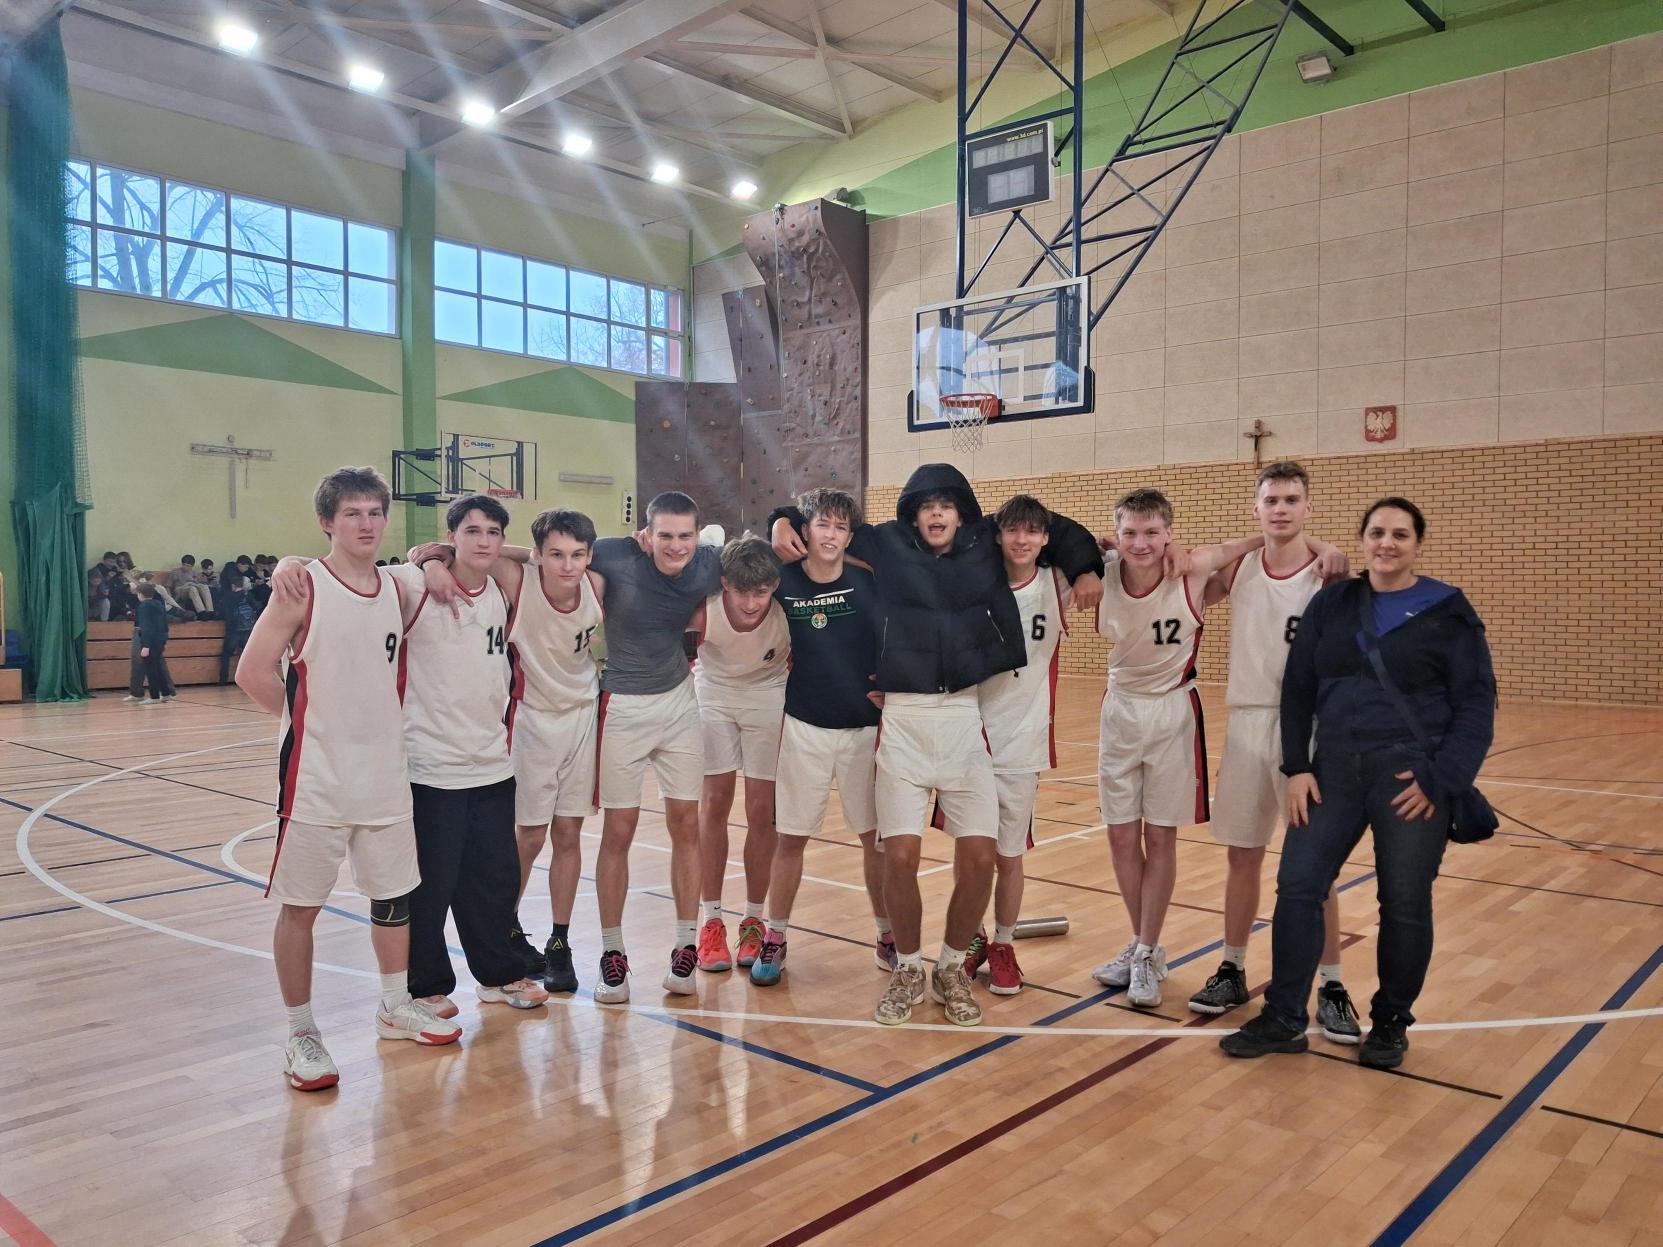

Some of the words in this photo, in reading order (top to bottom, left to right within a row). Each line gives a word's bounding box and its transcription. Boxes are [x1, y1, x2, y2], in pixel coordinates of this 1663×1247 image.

[787, 603, 852, 615] BASKETBALL
[792, 595, 846, 608] AKADEMIA
[485, 625, 505, 655] 14
[1031, 614, 1047, 641] 6
[1151, 618, 1182, 645] 12
[1284, 615, 1301, 643] 8
[385, 631, 397, 664] 9
[762, 647, 776, 663] 4
